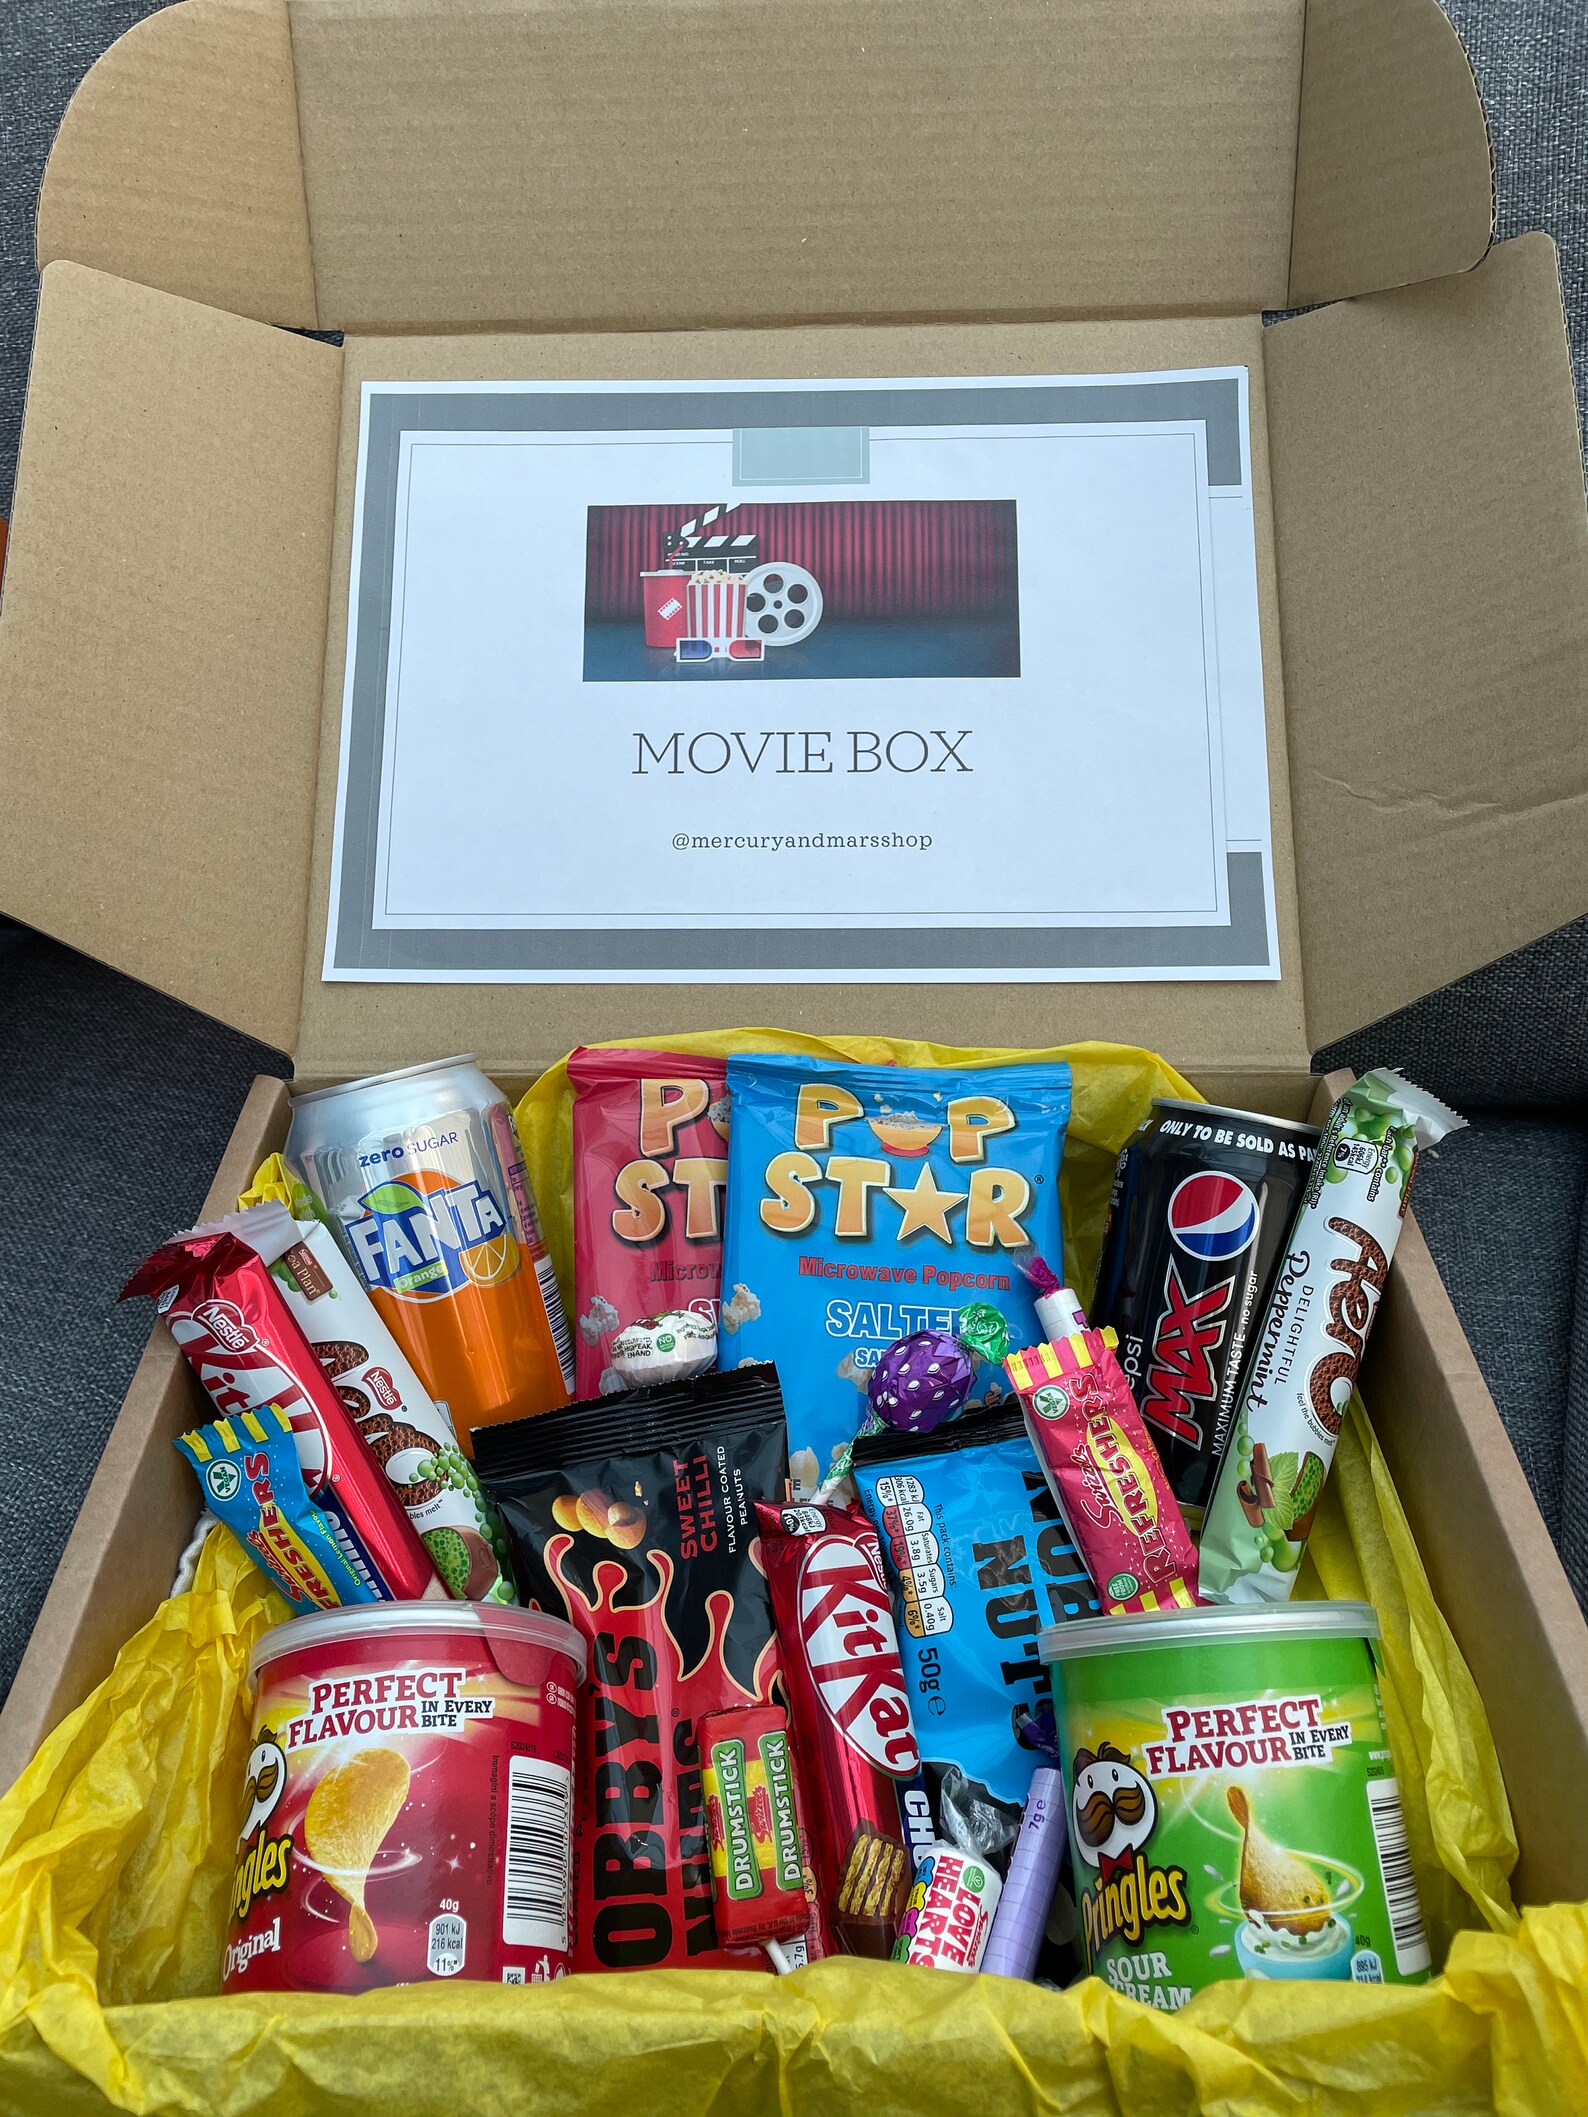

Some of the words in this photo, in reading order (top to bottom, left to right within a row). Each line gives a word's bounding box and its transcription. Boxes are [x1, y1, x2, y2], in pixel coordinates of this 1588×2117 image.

[632, 731, 833, 774] MOVIE
[847, 730, 974, 773] BOX
[672, 832, 933, 851] @mercuryandmarsshop
[358, 1146, 405, 1168] zero
[406, 1132, 459, 1156] SUGAR
[1159, 1120, 1192, 1139] ONLY
[1193, 1125, 1212, 1142] TO
[1214, 1129, 1234, 1146] BE
[1236, 1132, 1274, 1154] SOLD
[1278, 1141, 1298, 1159] AS
[1321, 1134, 1337, 1168] Reference
[1363, 1147, 1375, 1169] Energy
[1367, 1168, 1383, 1202] contains
[348, 1183, 503, 1283] FANTA
[299, 1267, 317, 1296] Plan
[398, 1265, 445, 1289] Orange
[798, 1255, 918, 1284] Microwave
[923, 1265, 1011, 1292] Popcorn
[1243, 1271, 1260, 1309] sugar
[203, 1306, 250, 1349] Nestlé
[826, 1301, 960, 1340] SALTE
[1240, 1310, 1251, 1326] no
[1246, 1250, 1310, 1413] Peppermint
[1274, 1285, 1315, 1385] DELIGHTFUL
[1309, 1216, 1389, 1437] Aero
[658, 1335, 672, 1345] NO
[1141, 1253, 1236, 1451] MAX
[1228, 1331, 1247, 1379] TASTE
[1125, 1334, 1144, 1391] epsi
[371, 1370, 397, 1406] Nestlé
[1211, 1379, 1236, 1457] MAXIMUM
[1301, 1407, 1310, 1420] the
[717, 1446, 730, 1493] COATED
[905, 1477, 917, 1494] 1283
[1069, 1372, 1177, 1585] REFRESHERS
[425, 1502, 441, 1516] melt
[673, 1459, 698, 1560] SWEET
[693, 1455, 718, 1552] CHILLI
[733, 1468, 748, 1525] PEANUTS
[864, 1488, 878, 1518] Energy
[898, 1489, 910, 1505] kcal
[934, 1504, 944, 1522] This
[721, 1495, 736, 1554] FLAVOUR
[783, 1514, 796, 1532] 10%
[809, 1508, 823, 1528] Energy
[902, 1507, 915, 1532] 26.0g
[916, 1511, 925, 1522] Fat
[936, 1522, 951, 1544] pack
[326, 1534, 343, 1560] Lemon
[910, 1539, 921, 1561] 3.8g
[341, 1557, 361, 1587] Original
[917, 1572, 928, 1594] 3.5g
[929, 1568, 939, 1594] Sugars
[943, 1546, 958, 1589] contains:
[924, 1603, 936, 1632] 0.40g
[937, 1606, 947, 1622] Salt
[801, 1565, 919, 1768] KitKat
[918, 1646, 942, 1695] 50g
[311, 1672, 463, 1716] PERFECT
[288, 1705, 419, 1749] FLAVOUR
[421, 1700, 438, 1714] IN
[444, 1700, 493, 1714] EVERY
[421, 1714, 457, 1728] BITE
[1166, 1698, 1320, 1744] PERFECT
[1146, 1736, 1293, 1775] FLAVOUR
[1289, 1732, 1307, 1746] IN
[1311, 1725, 1350, 1744] EVERY
[1292, 1744, 1327, 1761] BITE
[489, 1755, 500, 1795] Immagini
[489, 1802, 498, 1828] scopo
[588, 1631, 672, 1969] OBBY'S
[766, 1739, 802, 1882] DRUMSTICK
[719, 1747, 754, 1891] DRUMSTICK
[1028, 1812, 1045, 1830] 7g
[487, 1829, 499, 1887] dimostrativo
[439, 1898, 460, 1913] 40g
[908, 1855, 965, 1968] HEARTS
[1082, 1855, 1188, 1974] Pringles
[431, 1938, 445, 1950] 216
[447, 1937, 463, 1950] kcal
[435, 1923, 449, 1936] 901
[451, 1923, 461, 1936] kJ
[941, 1886, 982, 1968] LOVE
[1355, 1934, 1371, 1947] 40g
[223, 1917, 281, 1983] Original
[1106, 1951, 1172, 1986] SOUR
